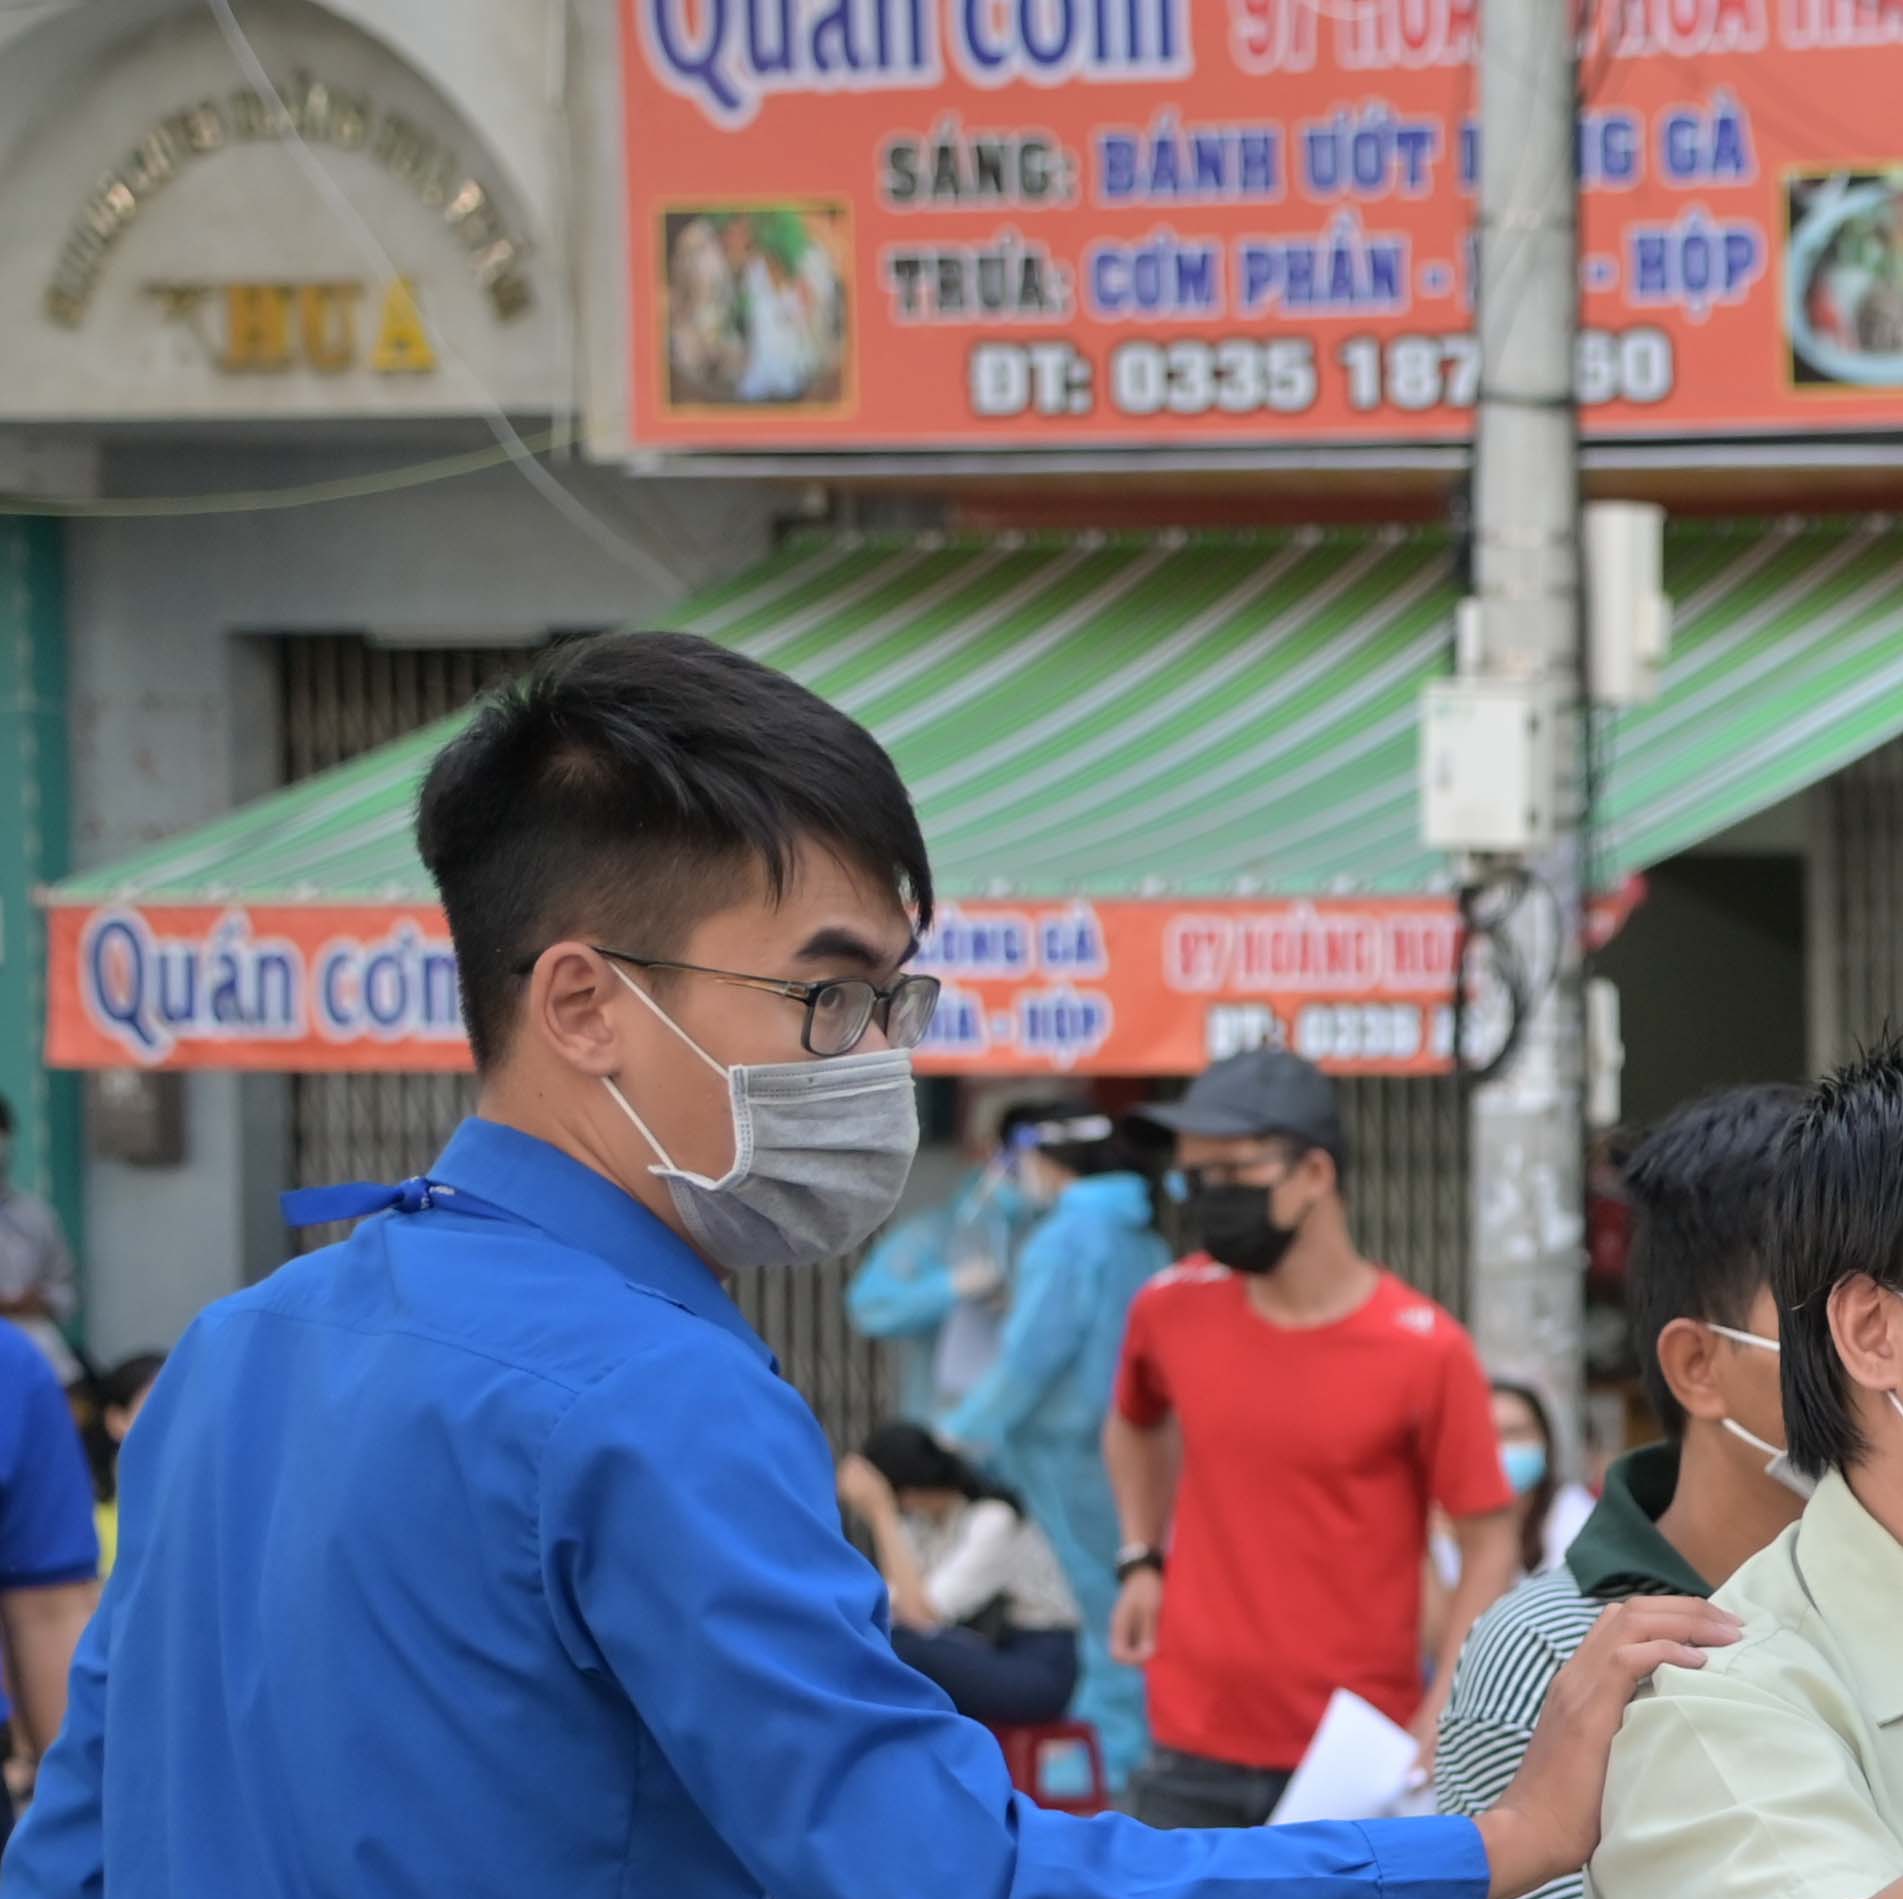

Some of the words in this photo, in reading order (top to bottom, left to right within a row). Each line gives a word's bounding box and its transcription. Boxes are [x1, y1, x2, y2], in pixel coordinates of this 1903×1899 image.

[1100, 105, 1284, 200] BÁNH
[1664, 92, 1752, 186] GÀ
[1092, 225, 1220, 312] CƠM
[1632, 208, 1758, 318] HỘP
[970, 343, 1094, 414] ĐT:
[1112, 341, 1316, 412] 0335
[88, 905, 295, 1050] Quán
